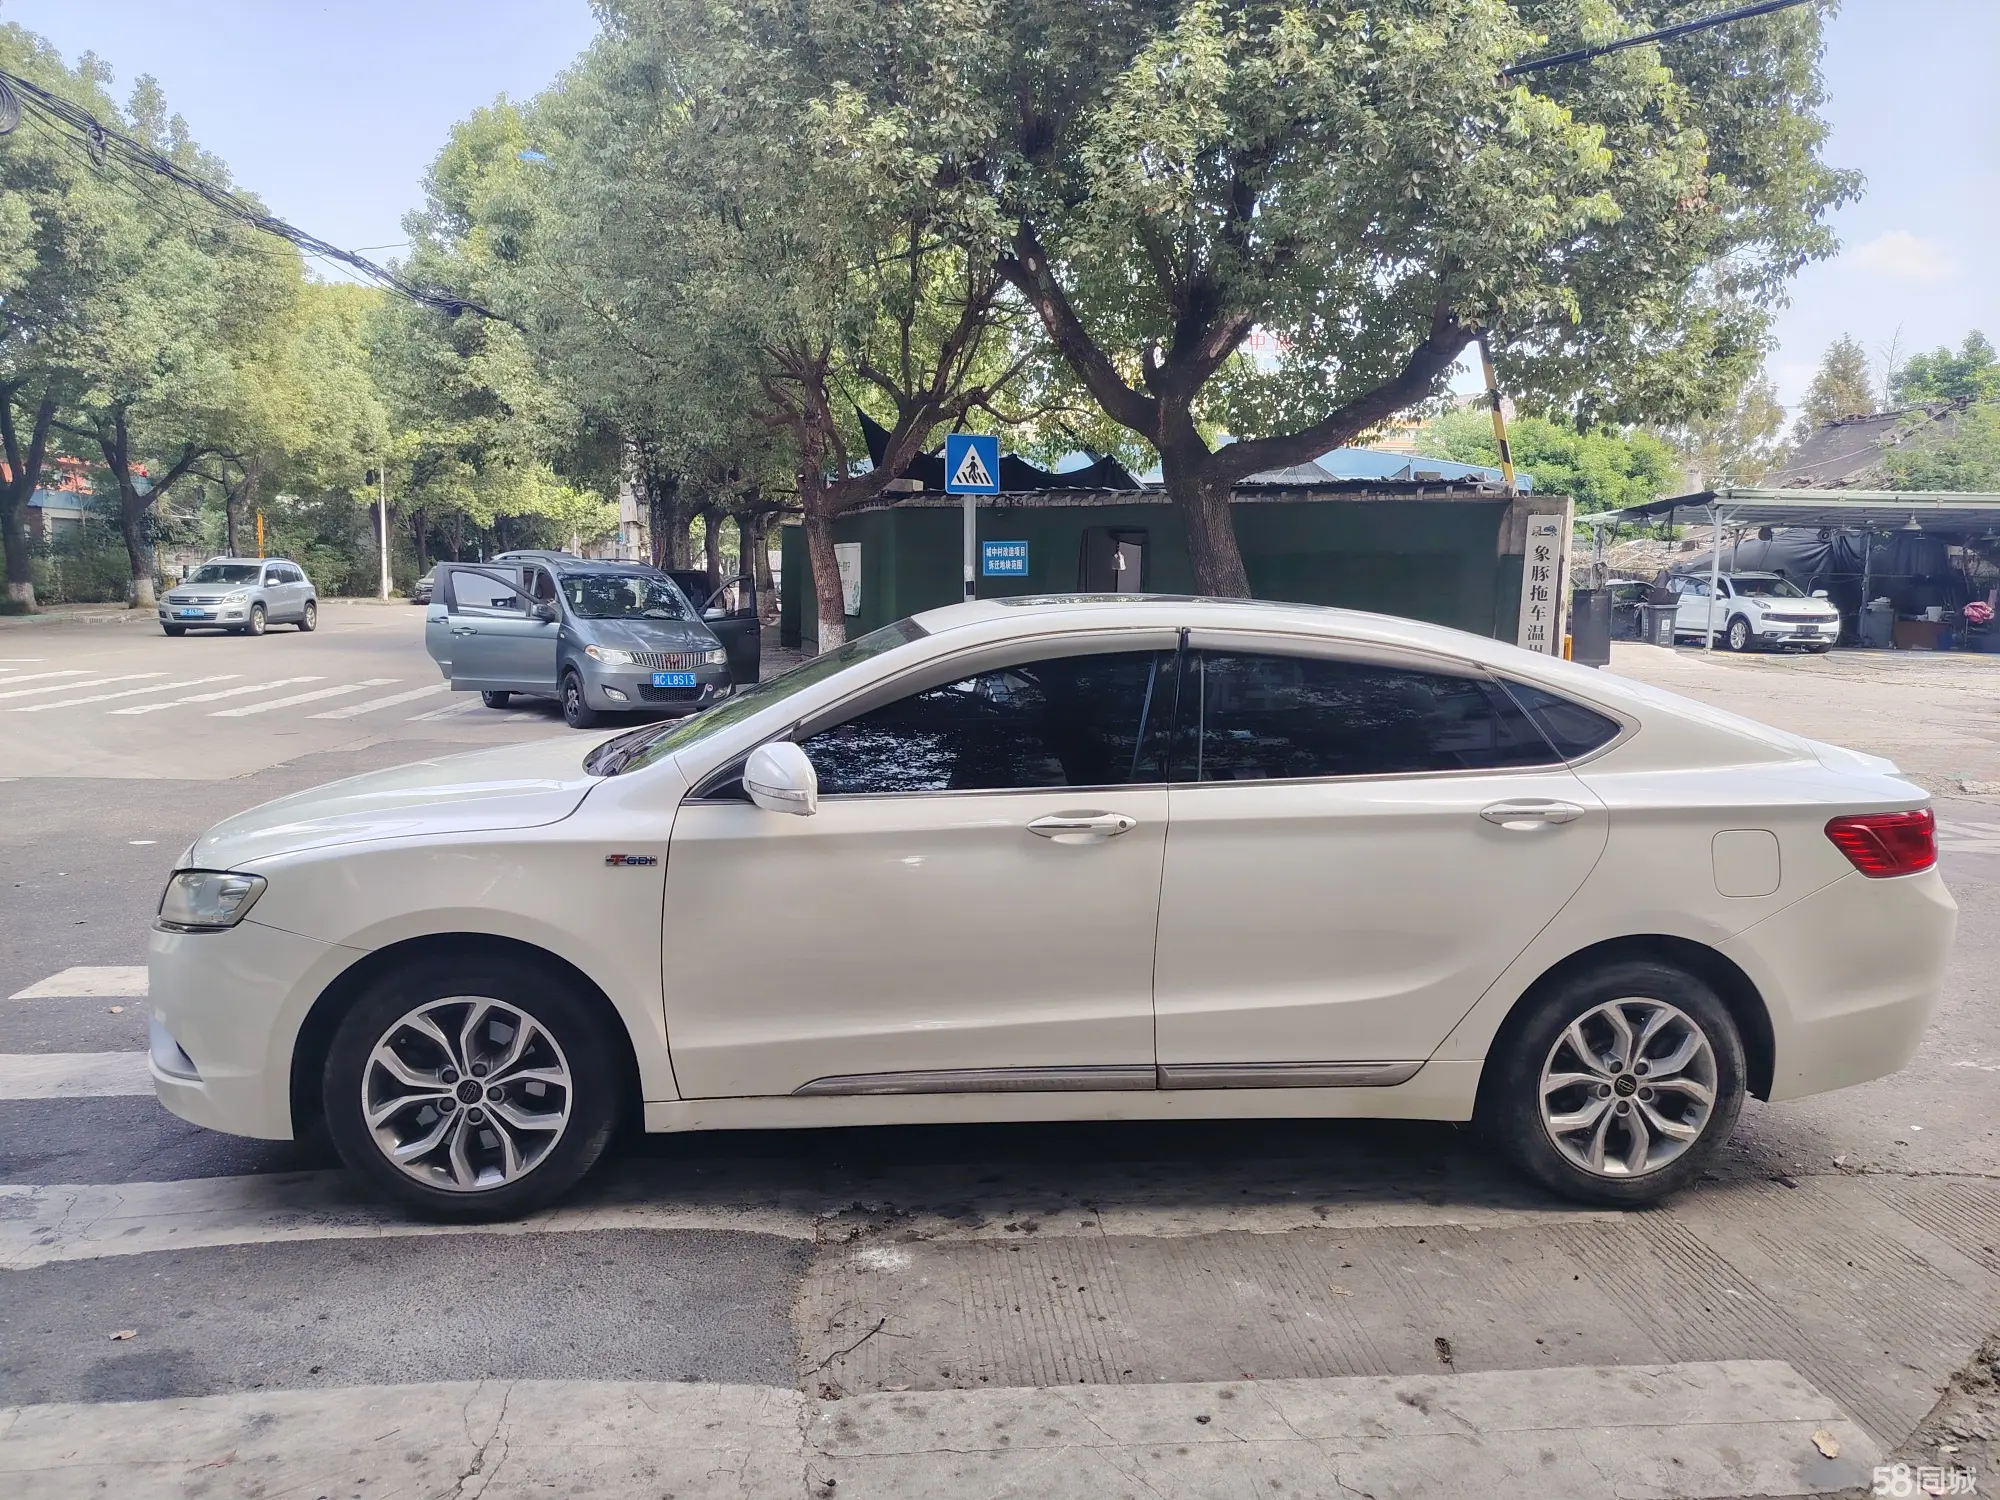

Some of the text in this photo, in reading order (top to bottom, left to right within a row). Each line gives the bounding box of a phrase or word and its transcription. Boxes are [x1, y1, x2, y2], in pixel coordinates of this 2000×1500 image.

[986, 546, 1025, 557] 城中村改造项目
[989, 560, 1022, 570] 拆迁地块范围
